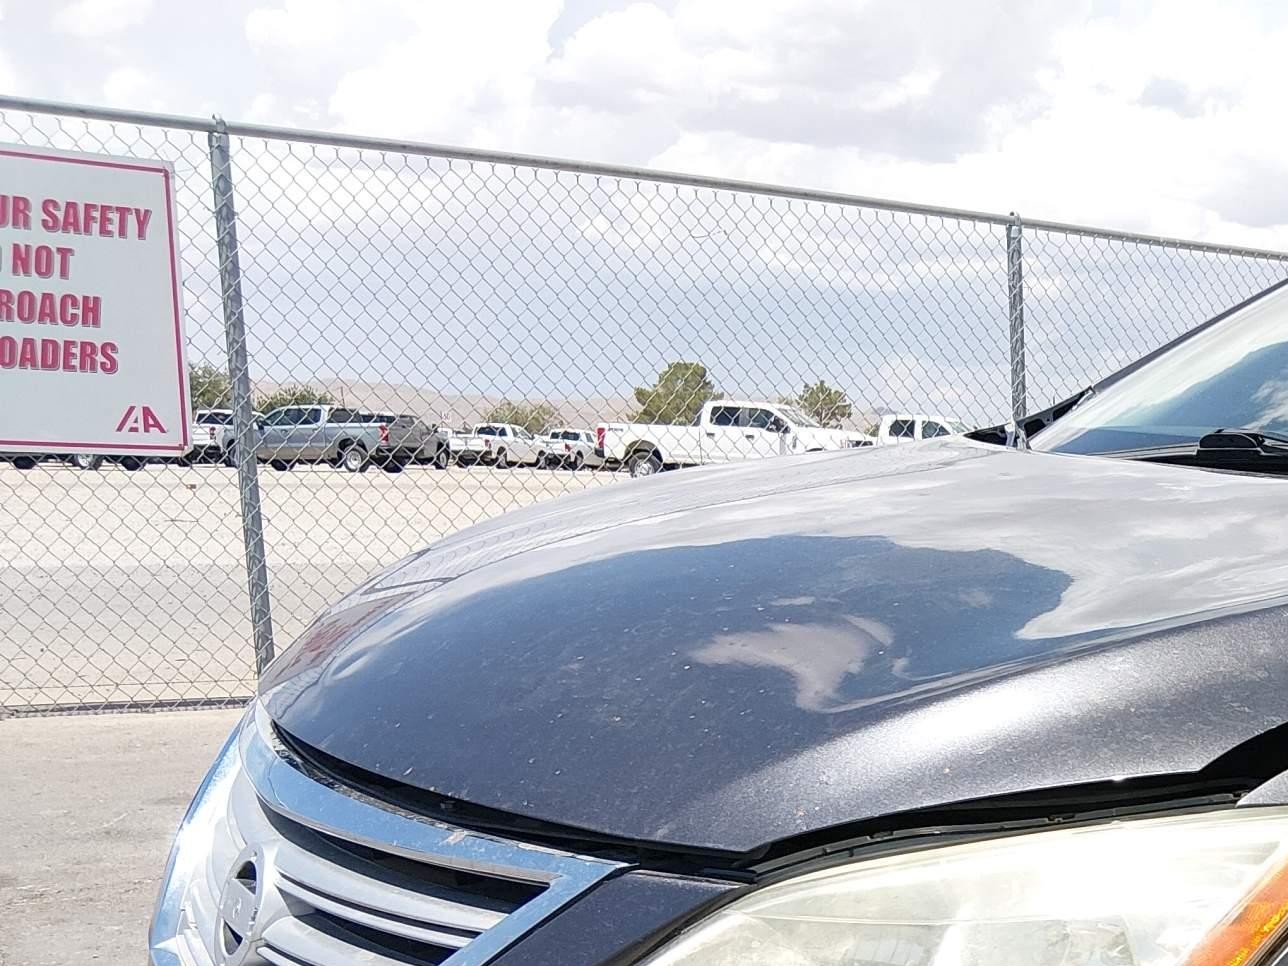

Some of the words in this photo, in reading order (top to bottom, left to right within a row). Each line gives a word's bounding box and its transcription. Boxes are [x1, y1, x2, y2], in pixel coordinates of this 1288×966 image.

[41, 198, 152, 241] SAFETY
[12, 243, 75, 280] NOT
[0, 288, 102, 328] ROACH
[0, 335, 119, 374] OADERS
